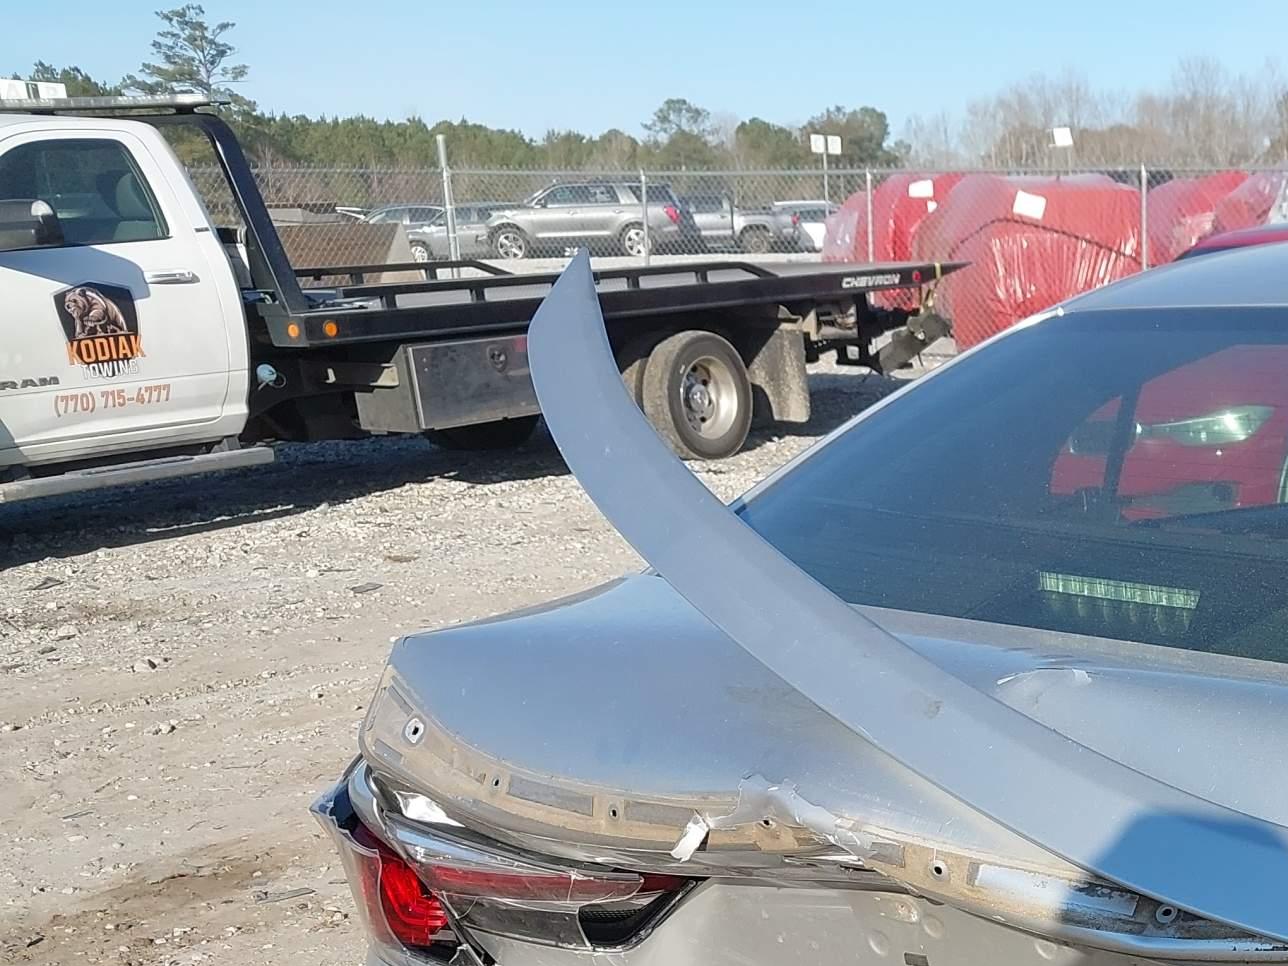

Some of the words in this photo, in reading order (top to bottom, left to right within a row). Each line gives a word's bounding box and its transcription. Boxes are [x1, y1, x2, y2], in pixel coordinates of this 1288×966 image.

[841, 273, 901, 289] CHEVRON
[65, 335, 146, 366] KODIAK
[80, 359, 140, 380] TOWING
[0, 376, 60, 391] RAM
[53, 391, 96, 418] (770)
[100, 383, 171, 410] 715-4777
